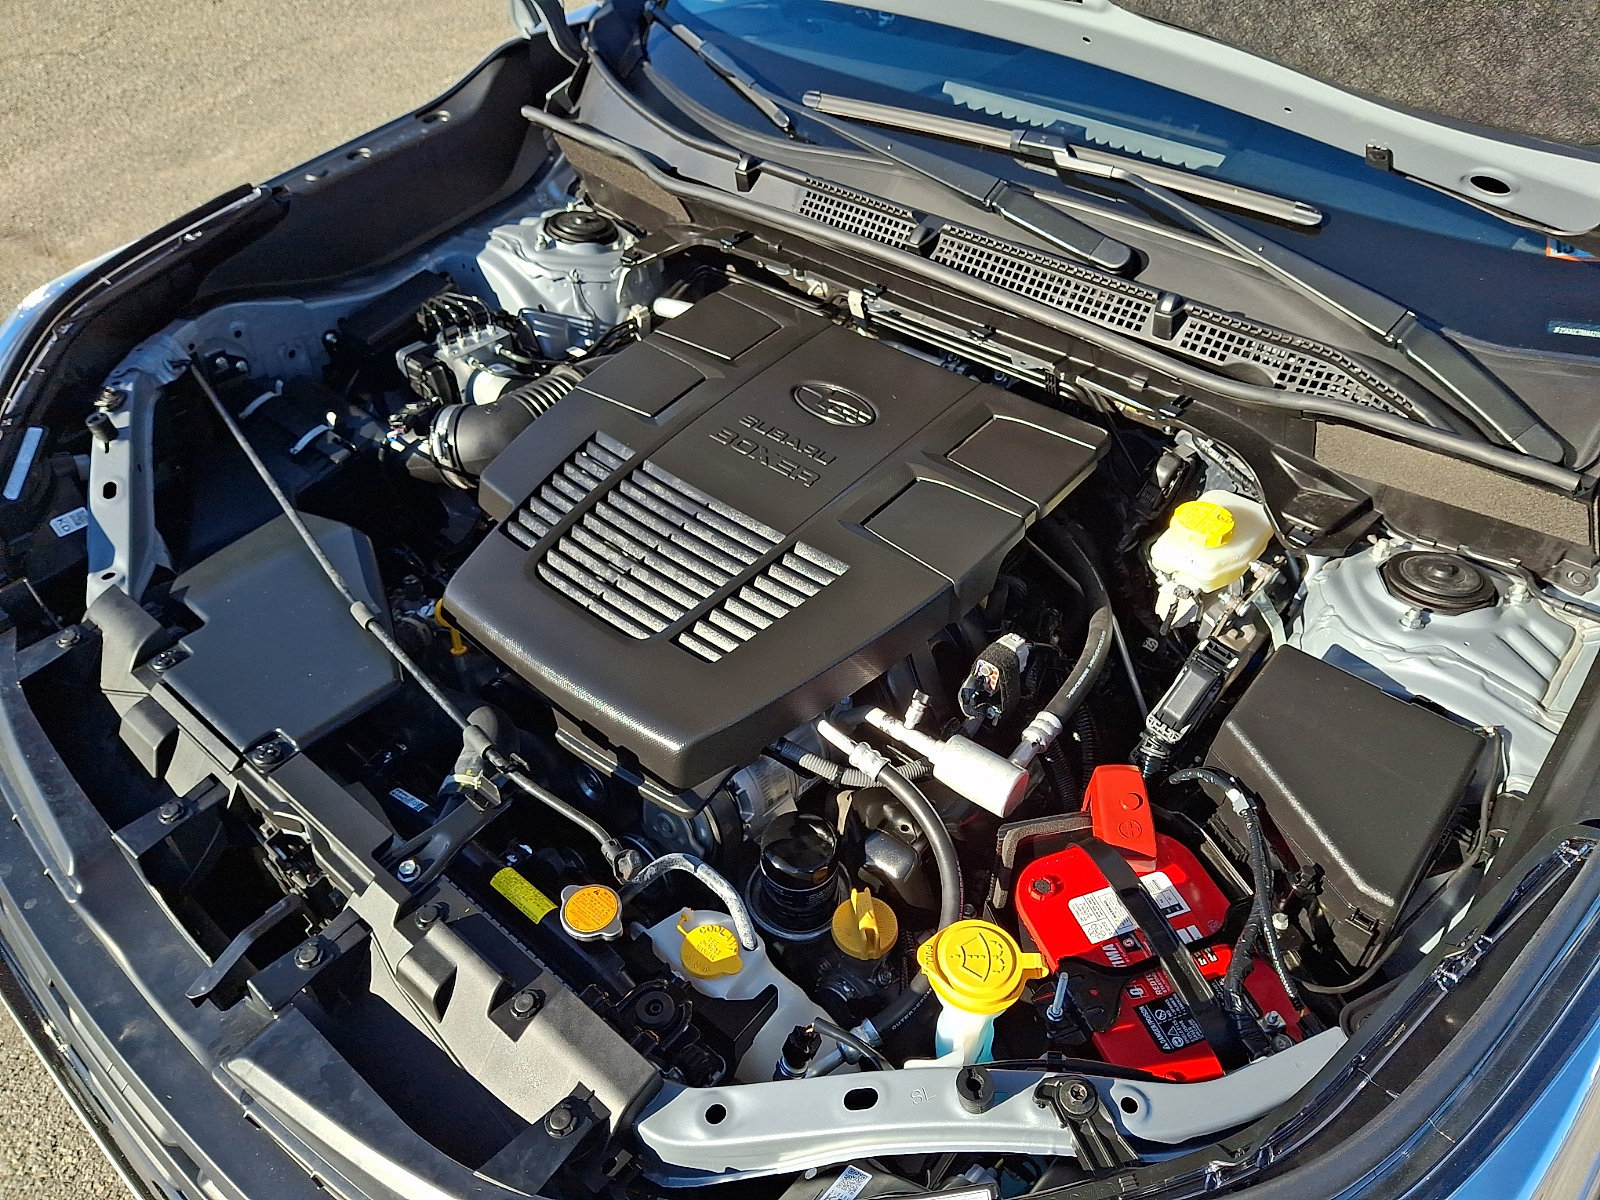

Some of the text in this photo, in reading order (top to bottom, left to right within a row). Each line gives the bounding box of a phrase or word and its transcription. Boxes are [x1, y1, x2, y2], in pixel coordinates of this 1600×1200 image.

[709, 426, 821, 488] BOXER
[739, 414, 837, 466] SUBARU
[1137, 1005, 1166, 1043] DANGER/POISON
